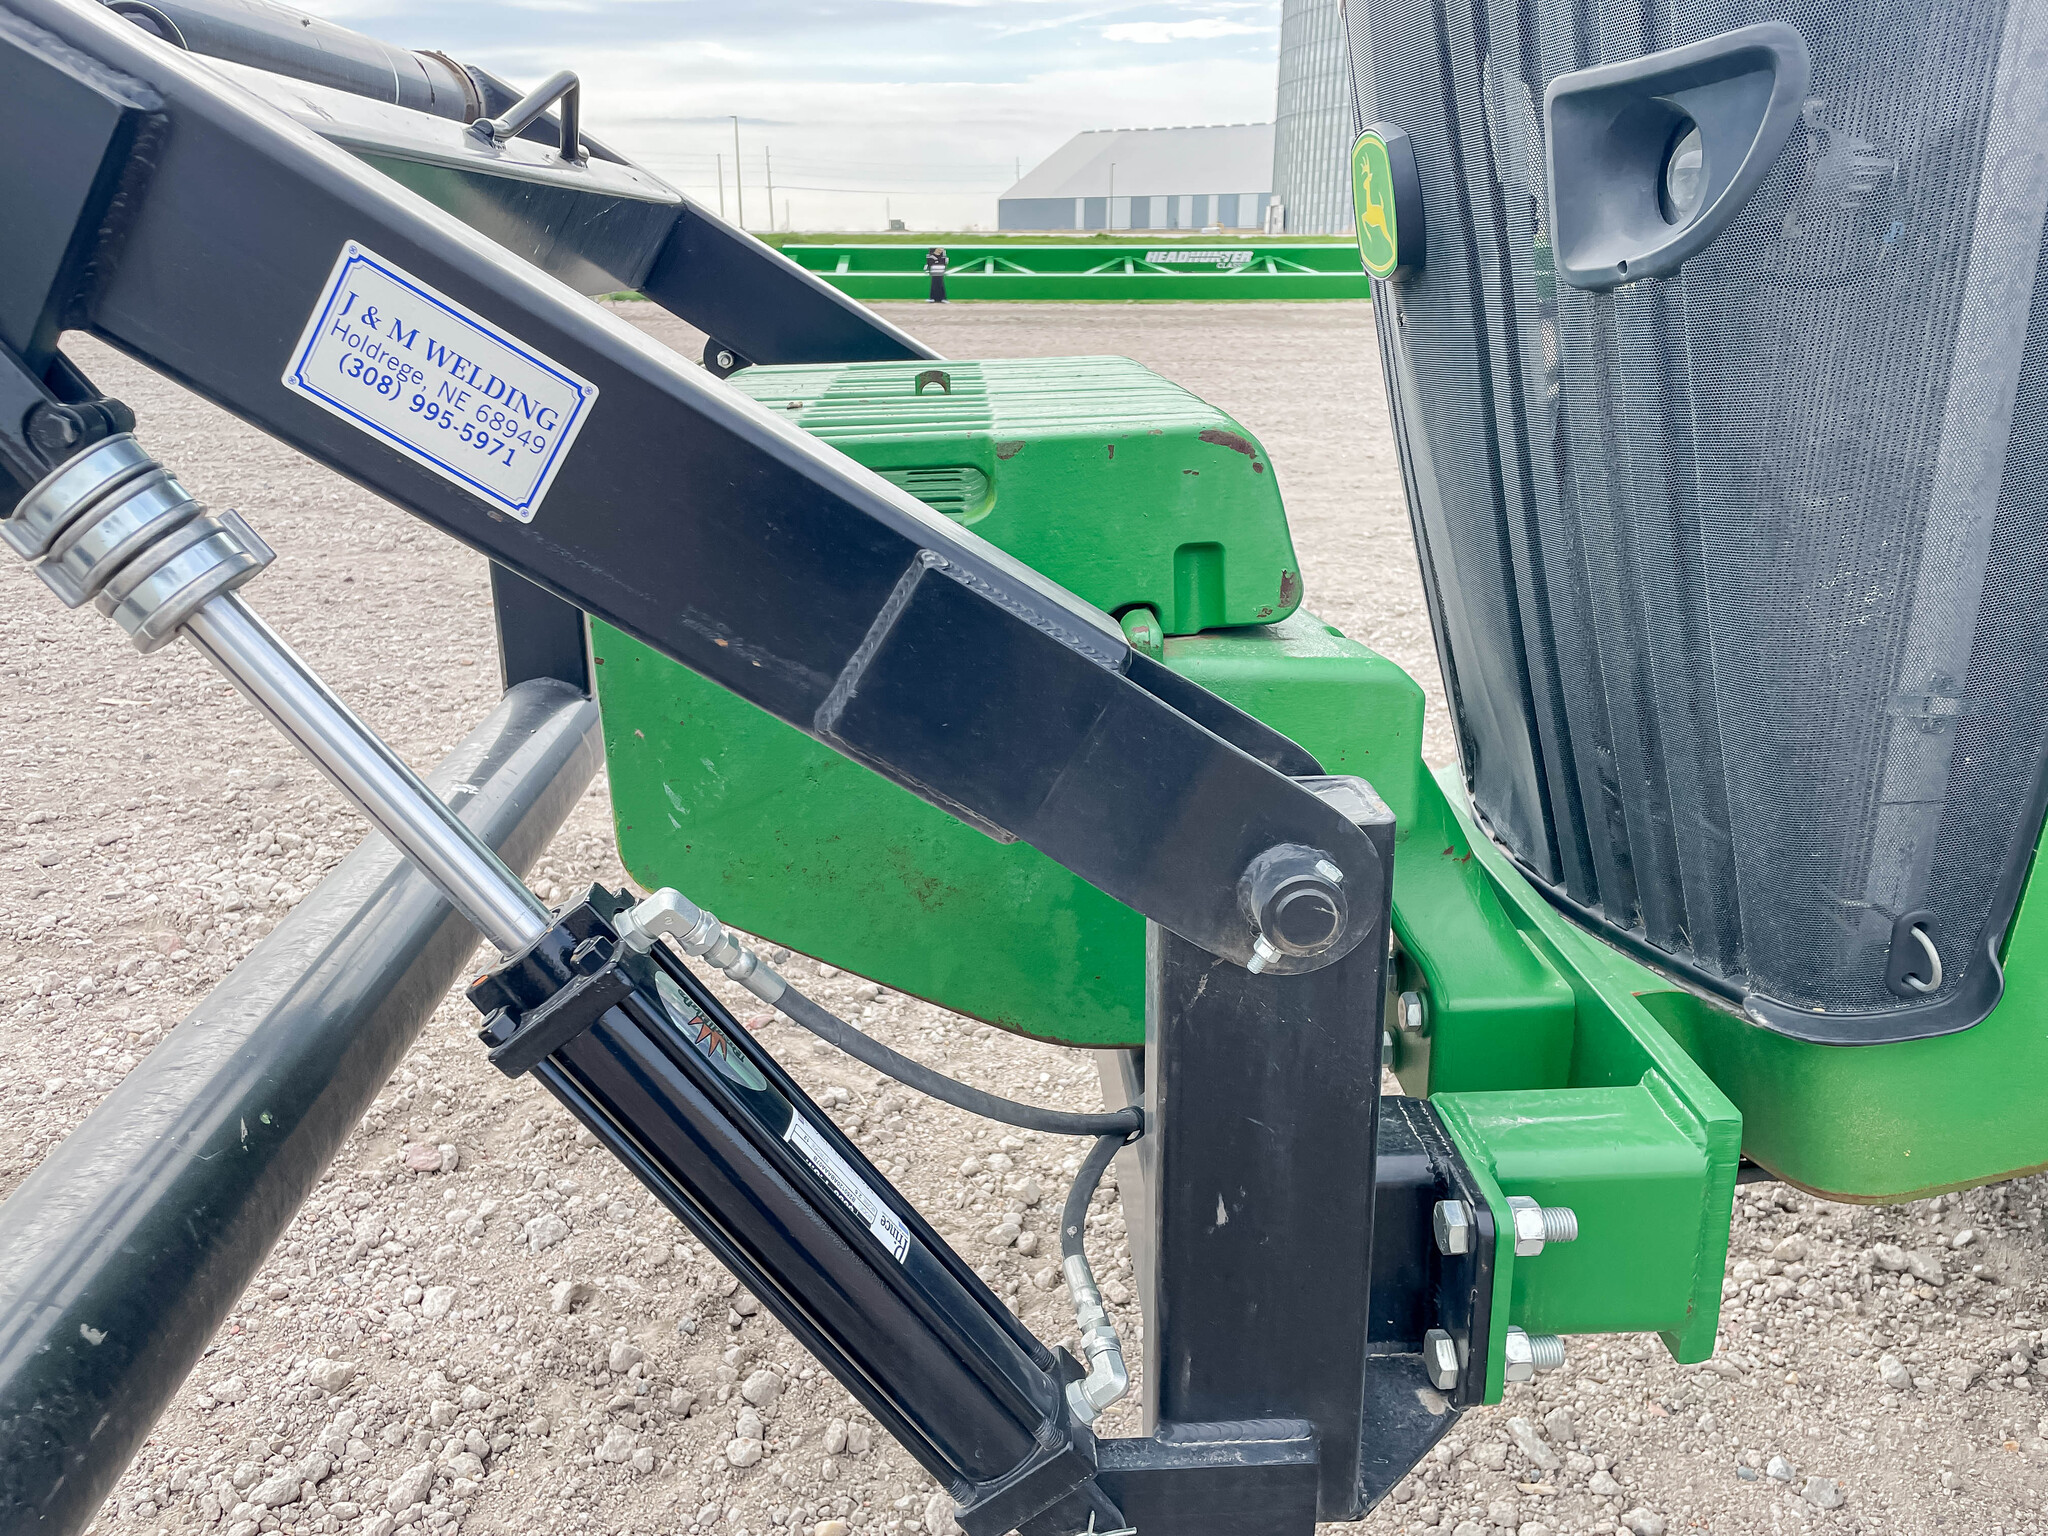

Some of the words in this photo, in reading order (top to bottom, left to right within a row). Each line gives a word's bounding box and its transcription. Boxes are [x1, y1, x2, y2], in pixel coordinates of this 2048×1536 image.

[331, 319, 427, 391] Holdrege,
[437, 381, 471, 411] NE
[476, 404, 546, 454] 68949
[338, 291, 359, 316] J
[361, 306, 381, 330] &
[387, 318, 420, 350] M
[426, 338, 559, 431] WELDING
[339, 353, 402, 401] (308)
[409, 394, 515, 467] 995-5971
[880, 1215, 908, 1261] Prince
